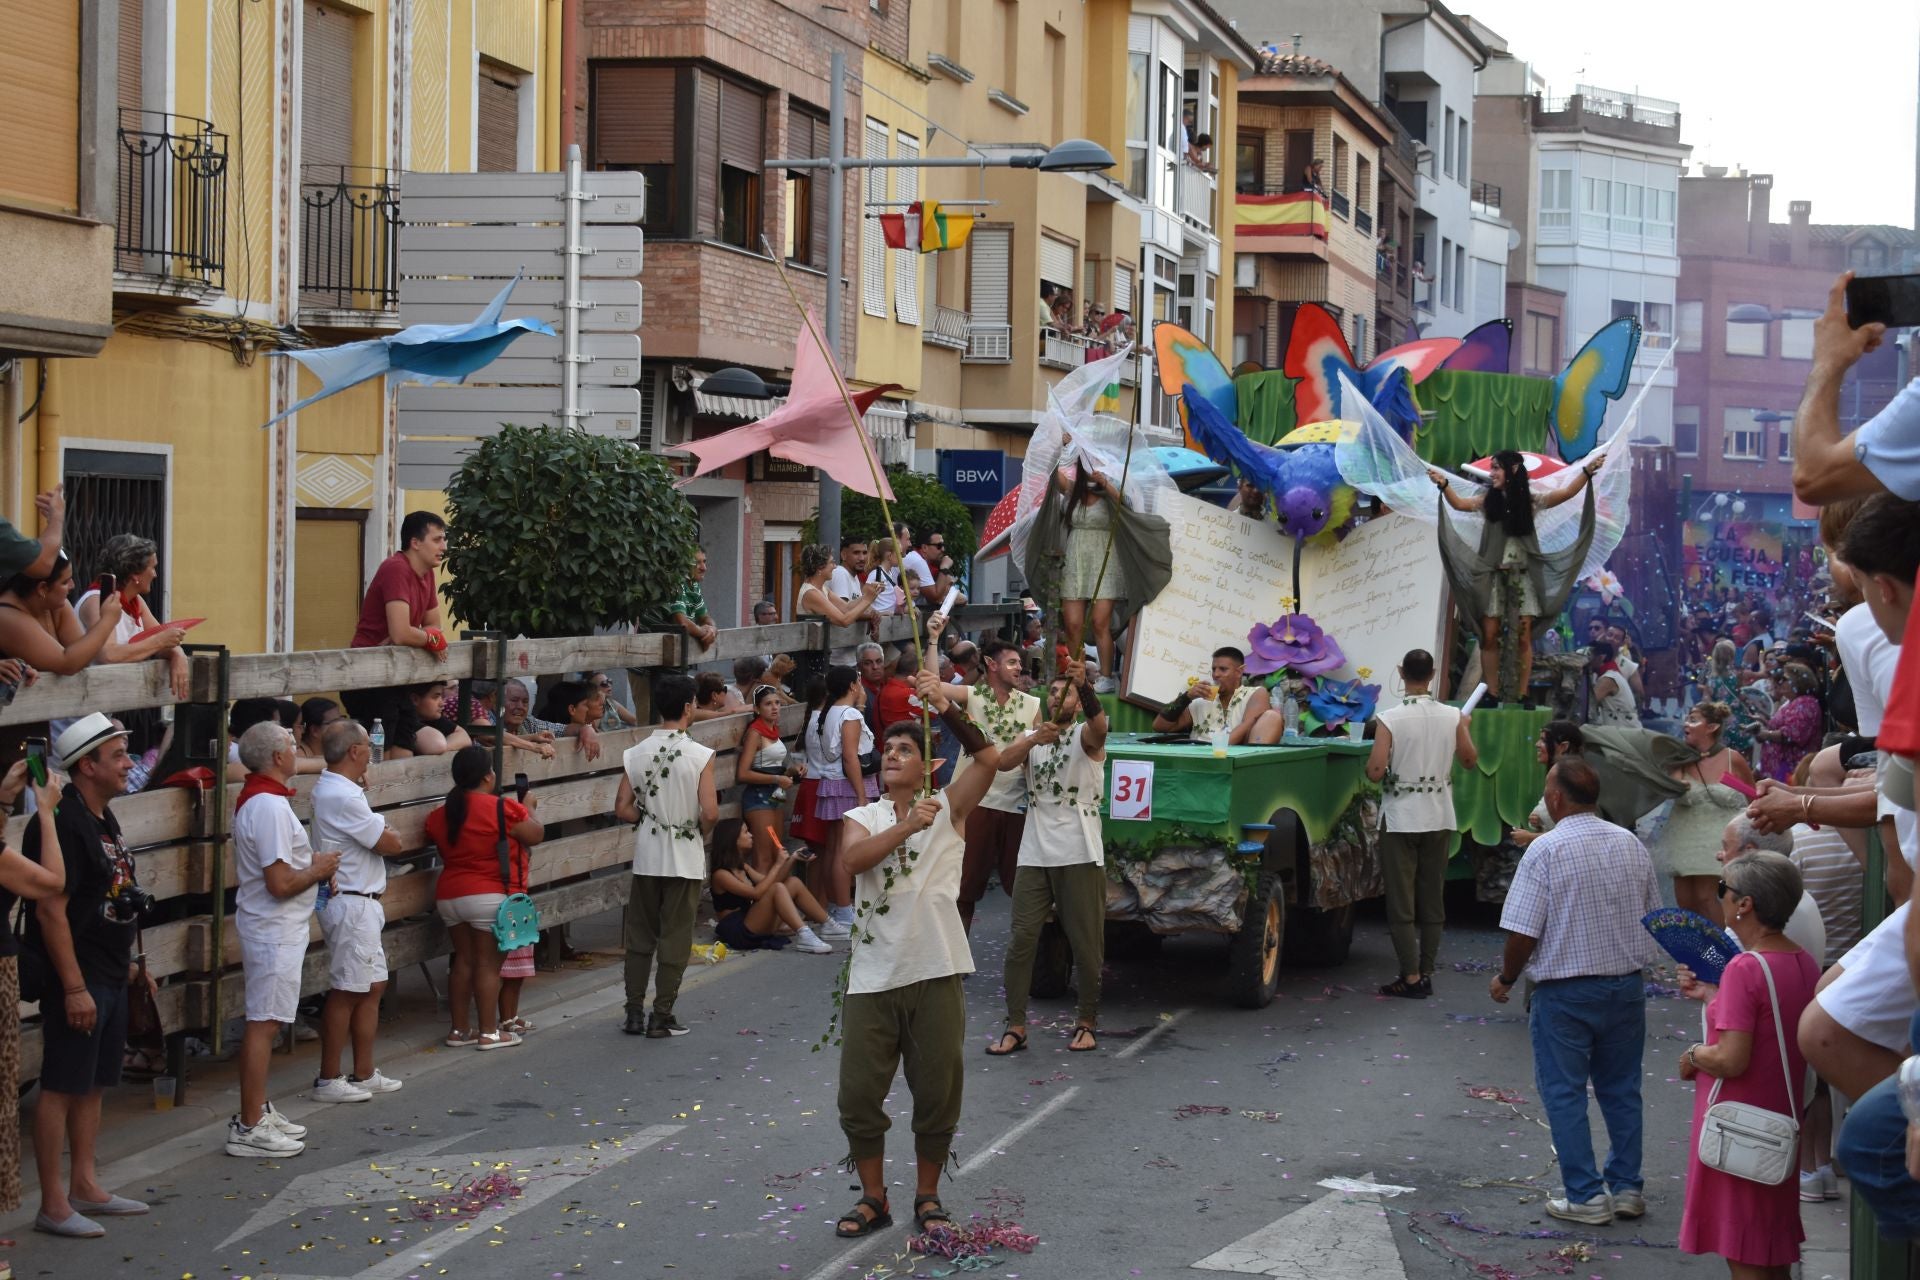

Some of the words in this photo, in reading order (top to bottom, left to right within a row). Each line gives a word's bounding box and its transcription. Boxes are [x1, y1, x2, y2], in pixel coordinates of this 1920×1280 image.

[956, 469, 998, 482] BBVA
[1714, 525, 1736, 542] LA
[1731, 569, 1777, 588] FEST
[1115, 775, 1147, 803] 31
